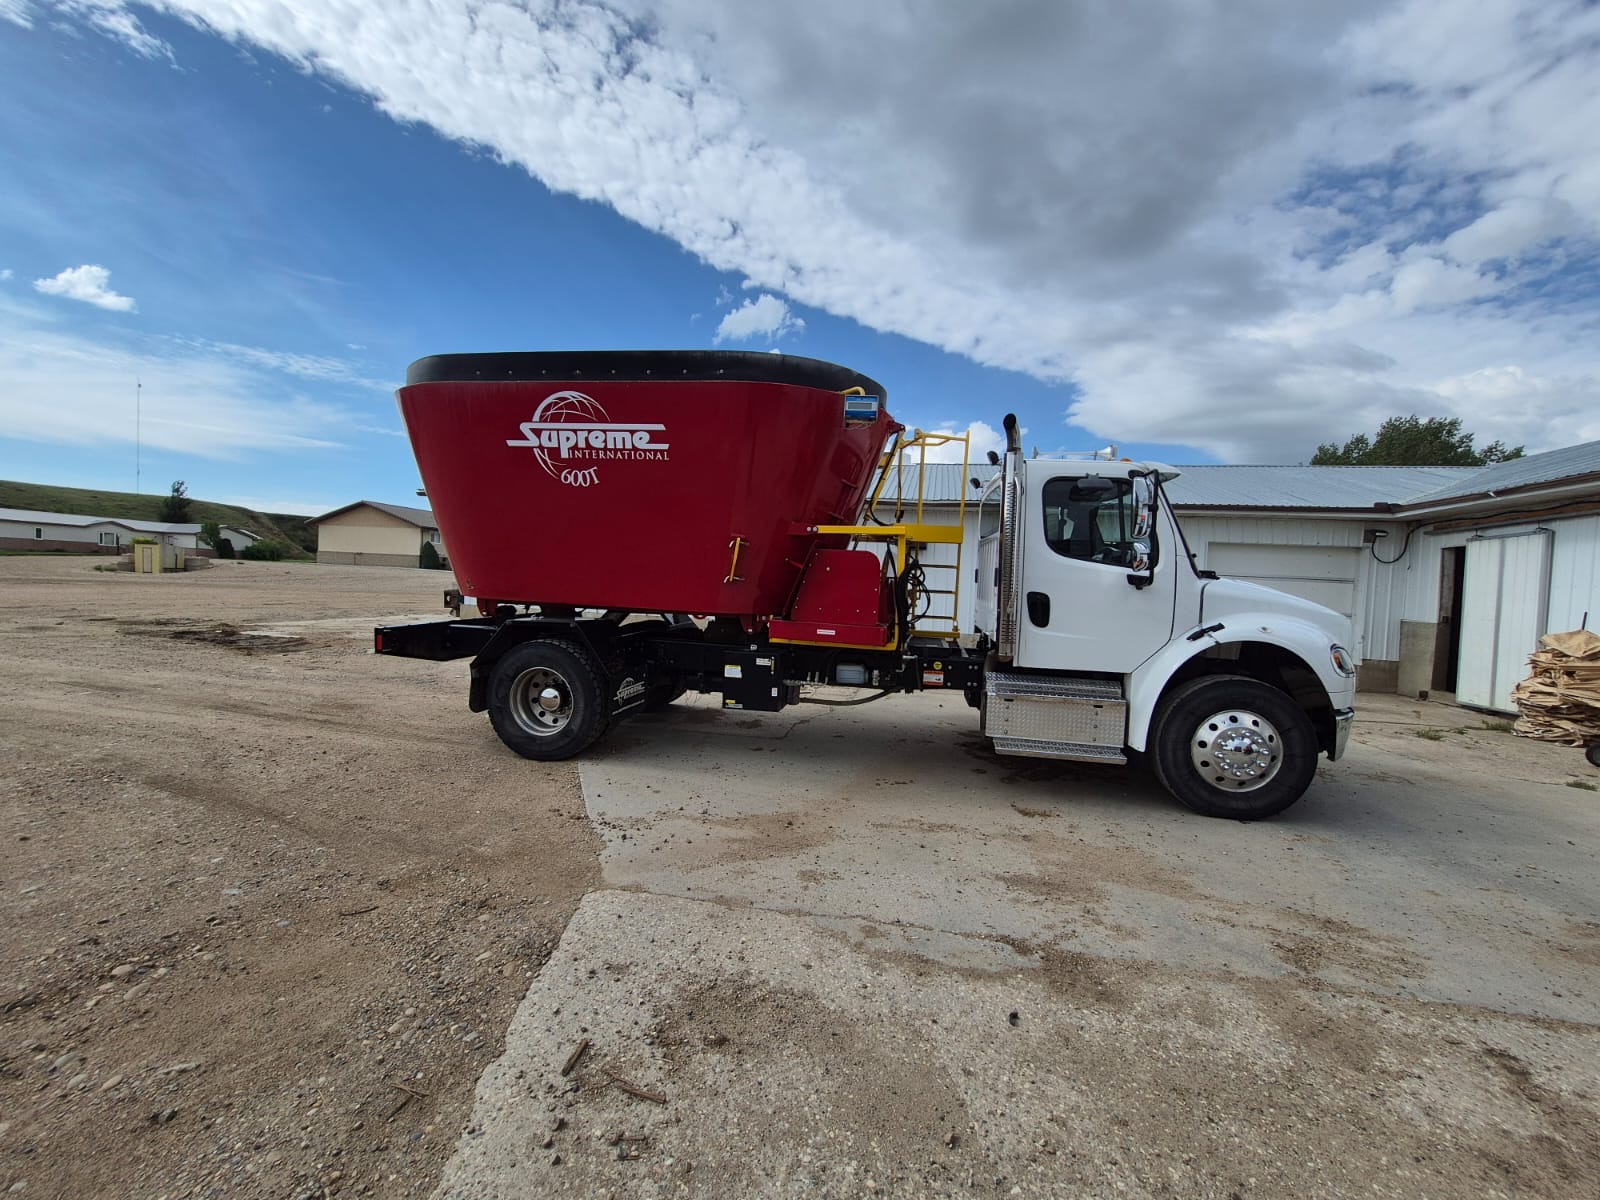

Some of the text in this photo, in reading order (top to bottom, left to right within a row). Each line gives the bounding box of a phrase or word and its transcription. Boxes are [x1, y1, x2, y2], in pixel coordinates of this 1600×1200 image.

[506, 422, 670, 459] Supreme
[569, 449, 670, 461] INTERNATIONAL
[560, 466, 600, 487] 600T
